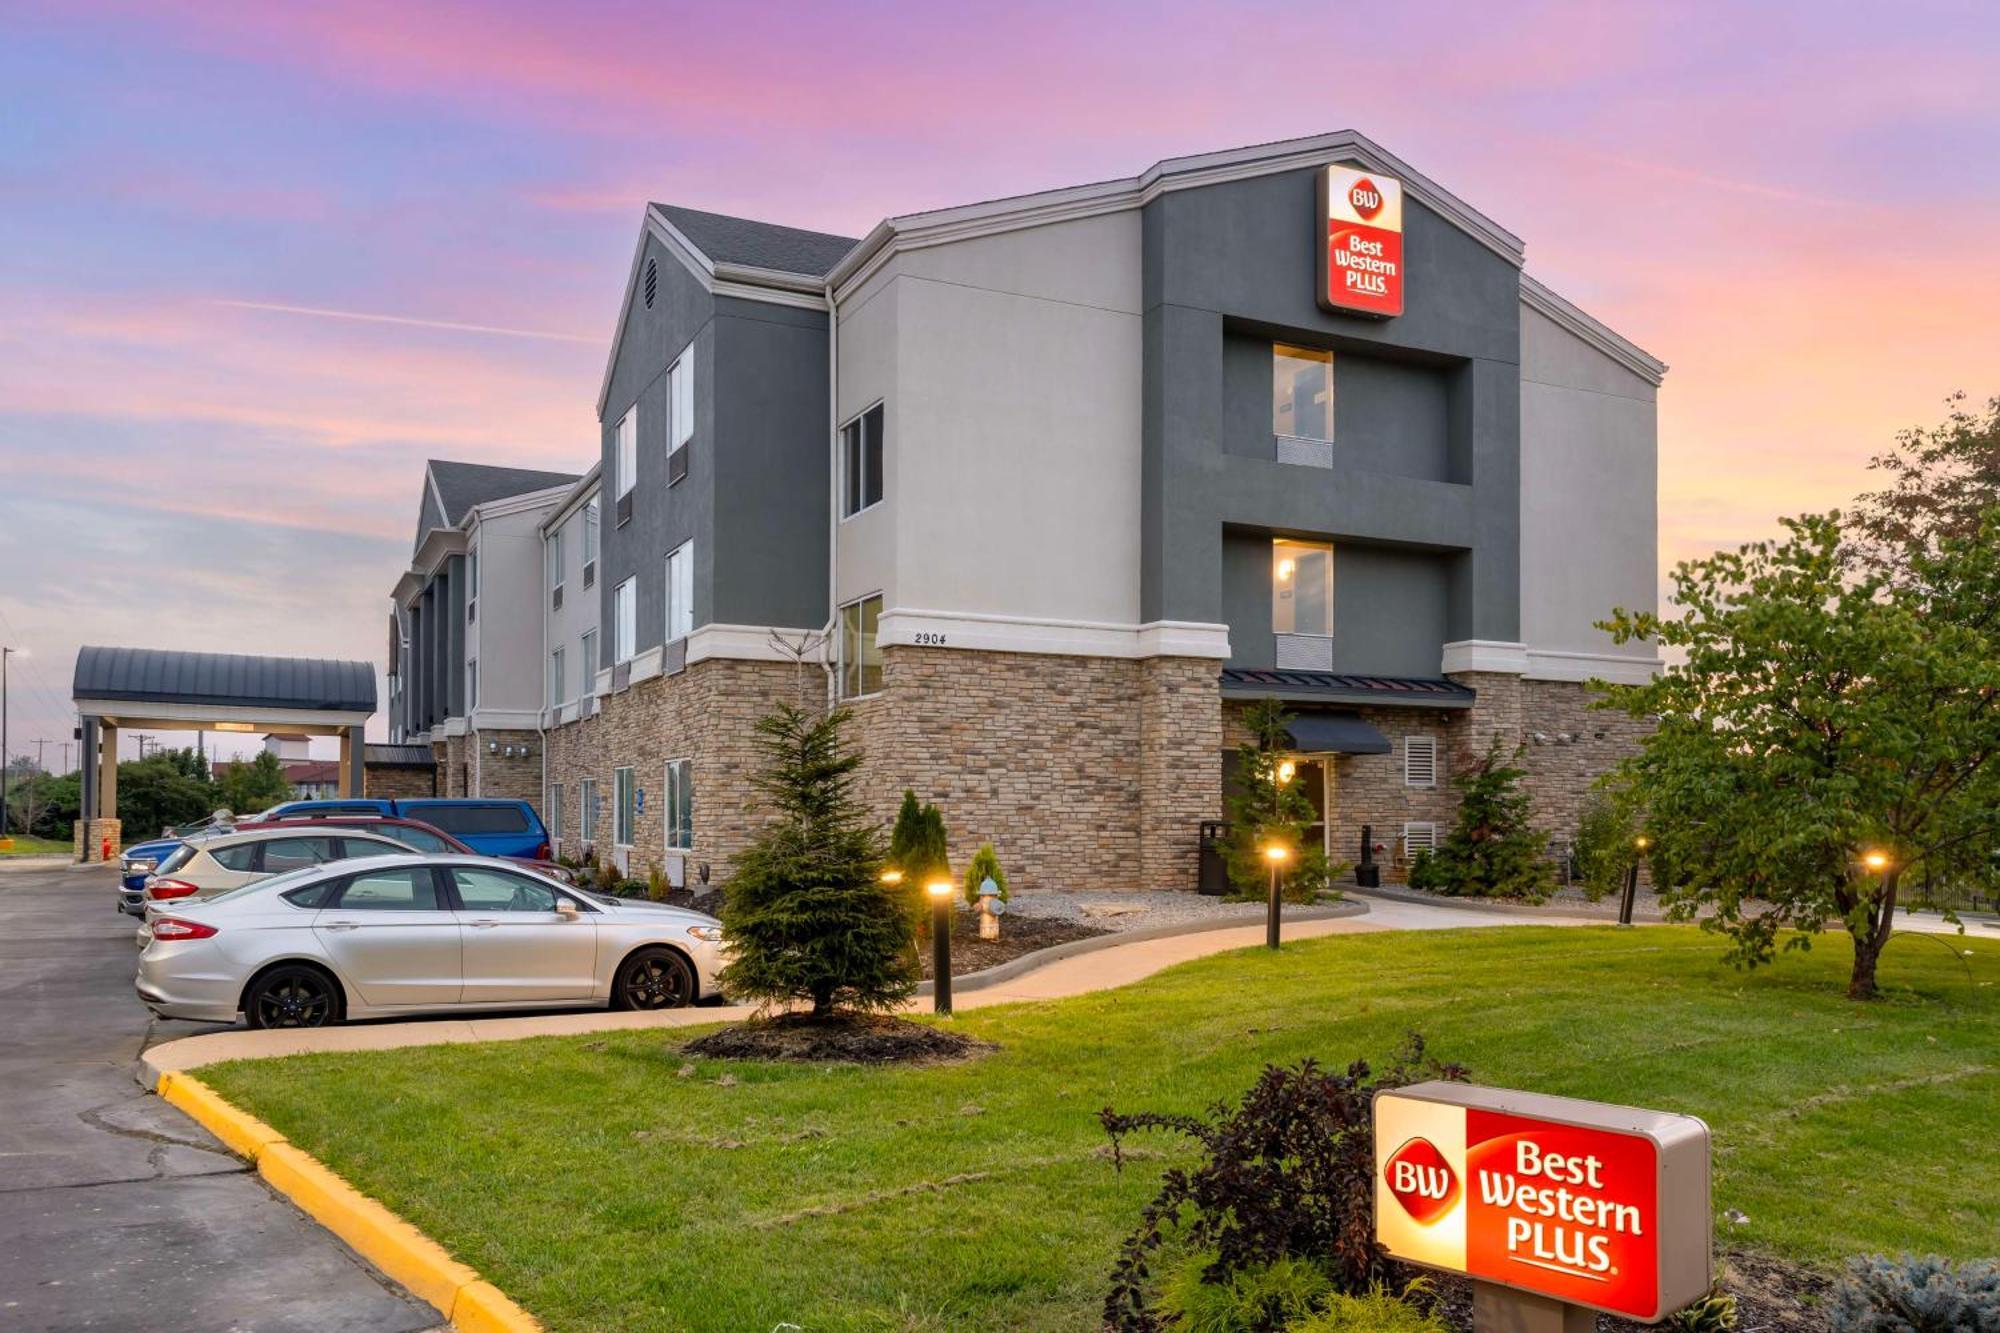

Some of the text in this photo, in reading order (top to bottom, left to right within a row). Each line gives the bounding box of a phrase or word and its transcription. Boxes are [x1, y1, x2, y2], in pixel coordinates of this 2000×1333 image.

[1352, 189, 1379, 209] BW
[1350, 235, 1383, 257] Best
[1334, 249, 1396, 276] Western
[914, 632, 946, 645] 2904
[1516, 1140, 1604, 1189] Best
[1395, 1160, 1448, 1200] BW
[1479, 1169, 1643, 1236] Western
